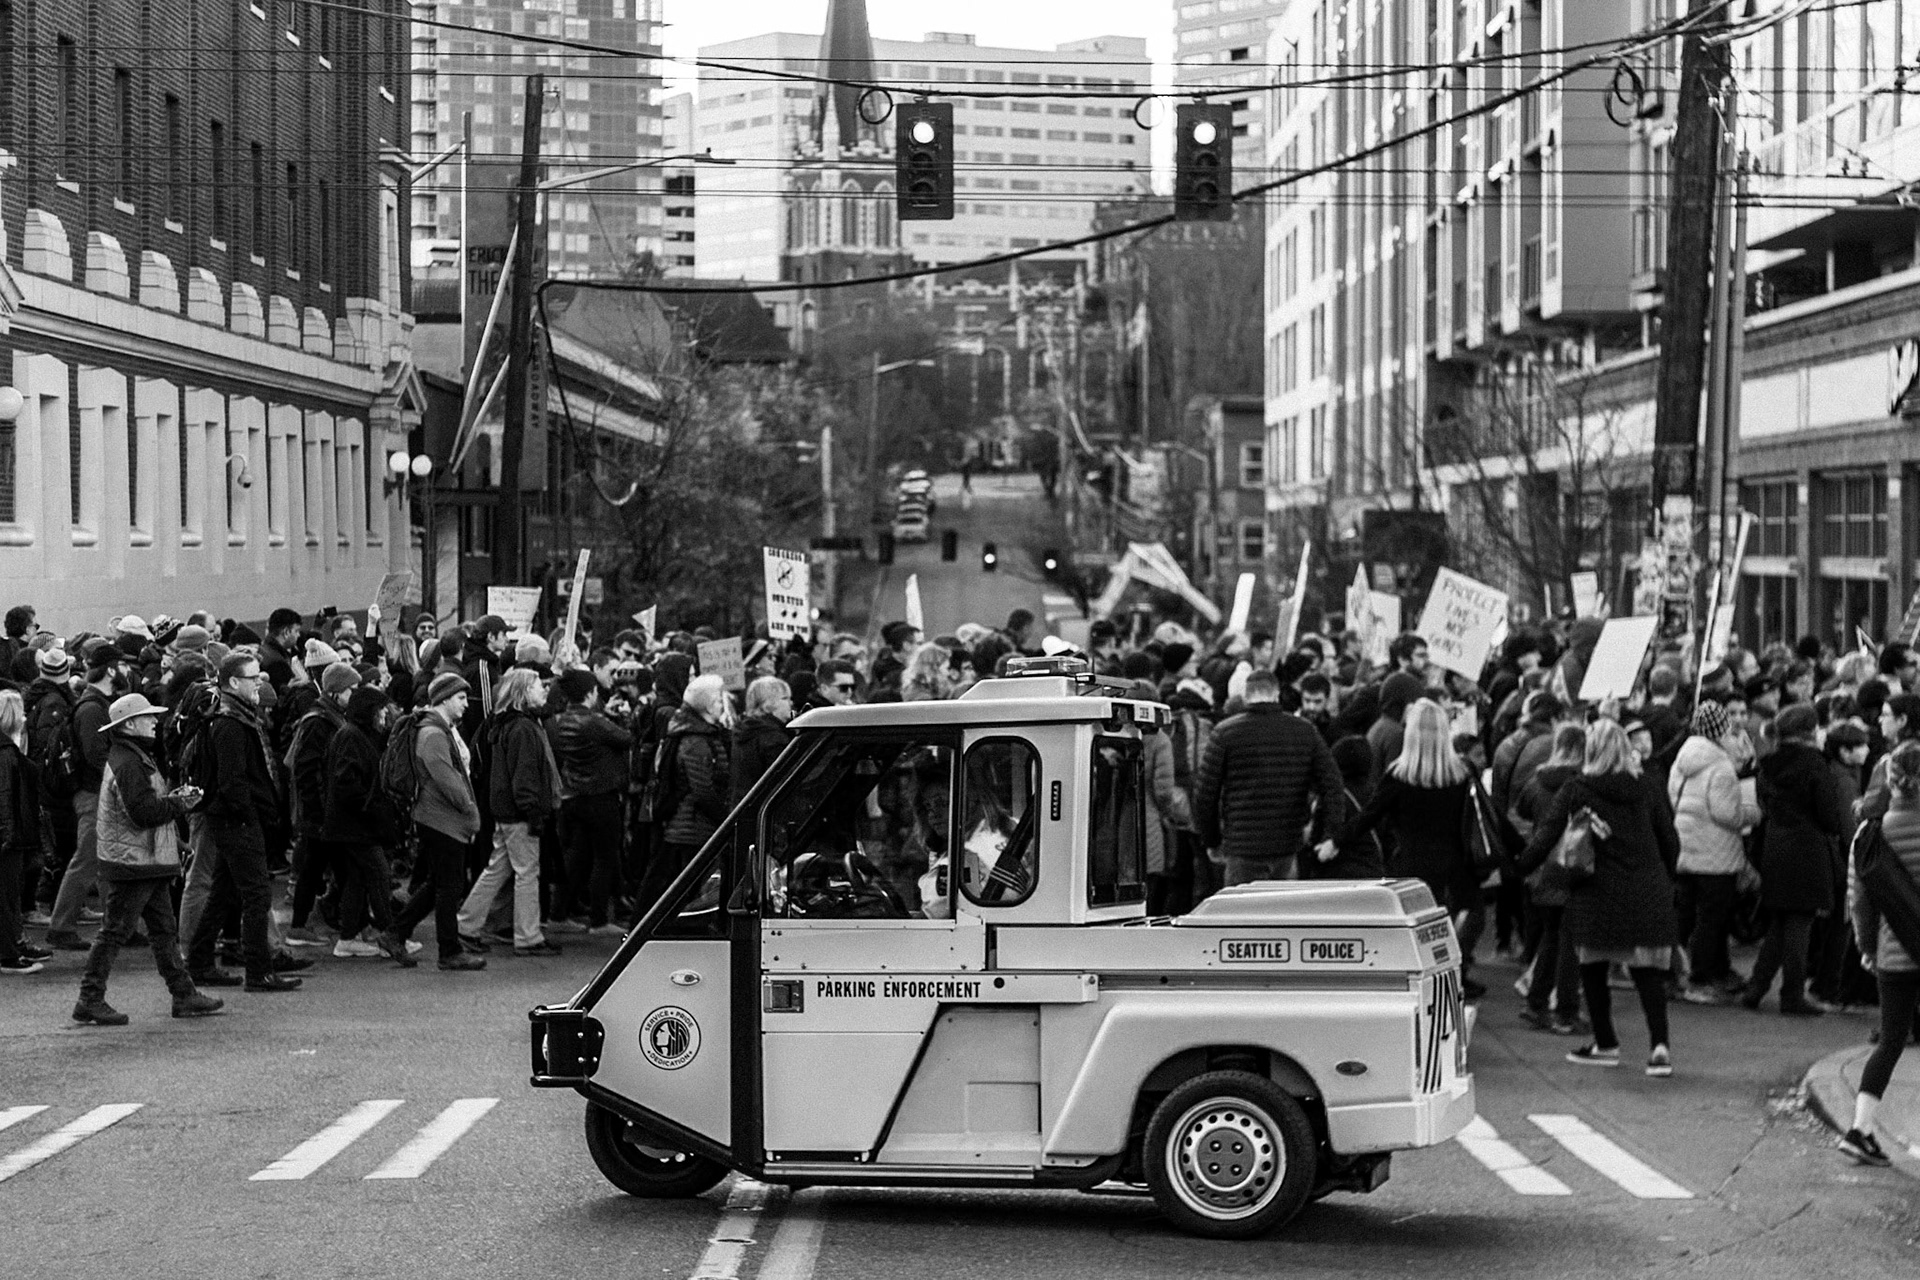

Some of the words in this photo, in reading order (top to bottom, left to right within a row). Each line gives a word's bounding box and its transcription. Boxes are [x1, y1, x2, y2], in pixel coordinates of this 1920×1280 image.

[1227, 942, 1283, 959] SEATTLE
[1309, 942, 1355, 959] POLICE
[817, 981, 876, 998] PARKING
[883, 981, 982, 998] ENFORCEMENT
[644, 1010, 669, 1032] SERVICE
[675, 1011, 695, 1028] PRIDE
[649, 1052, 690, 1067] DEDICATION
